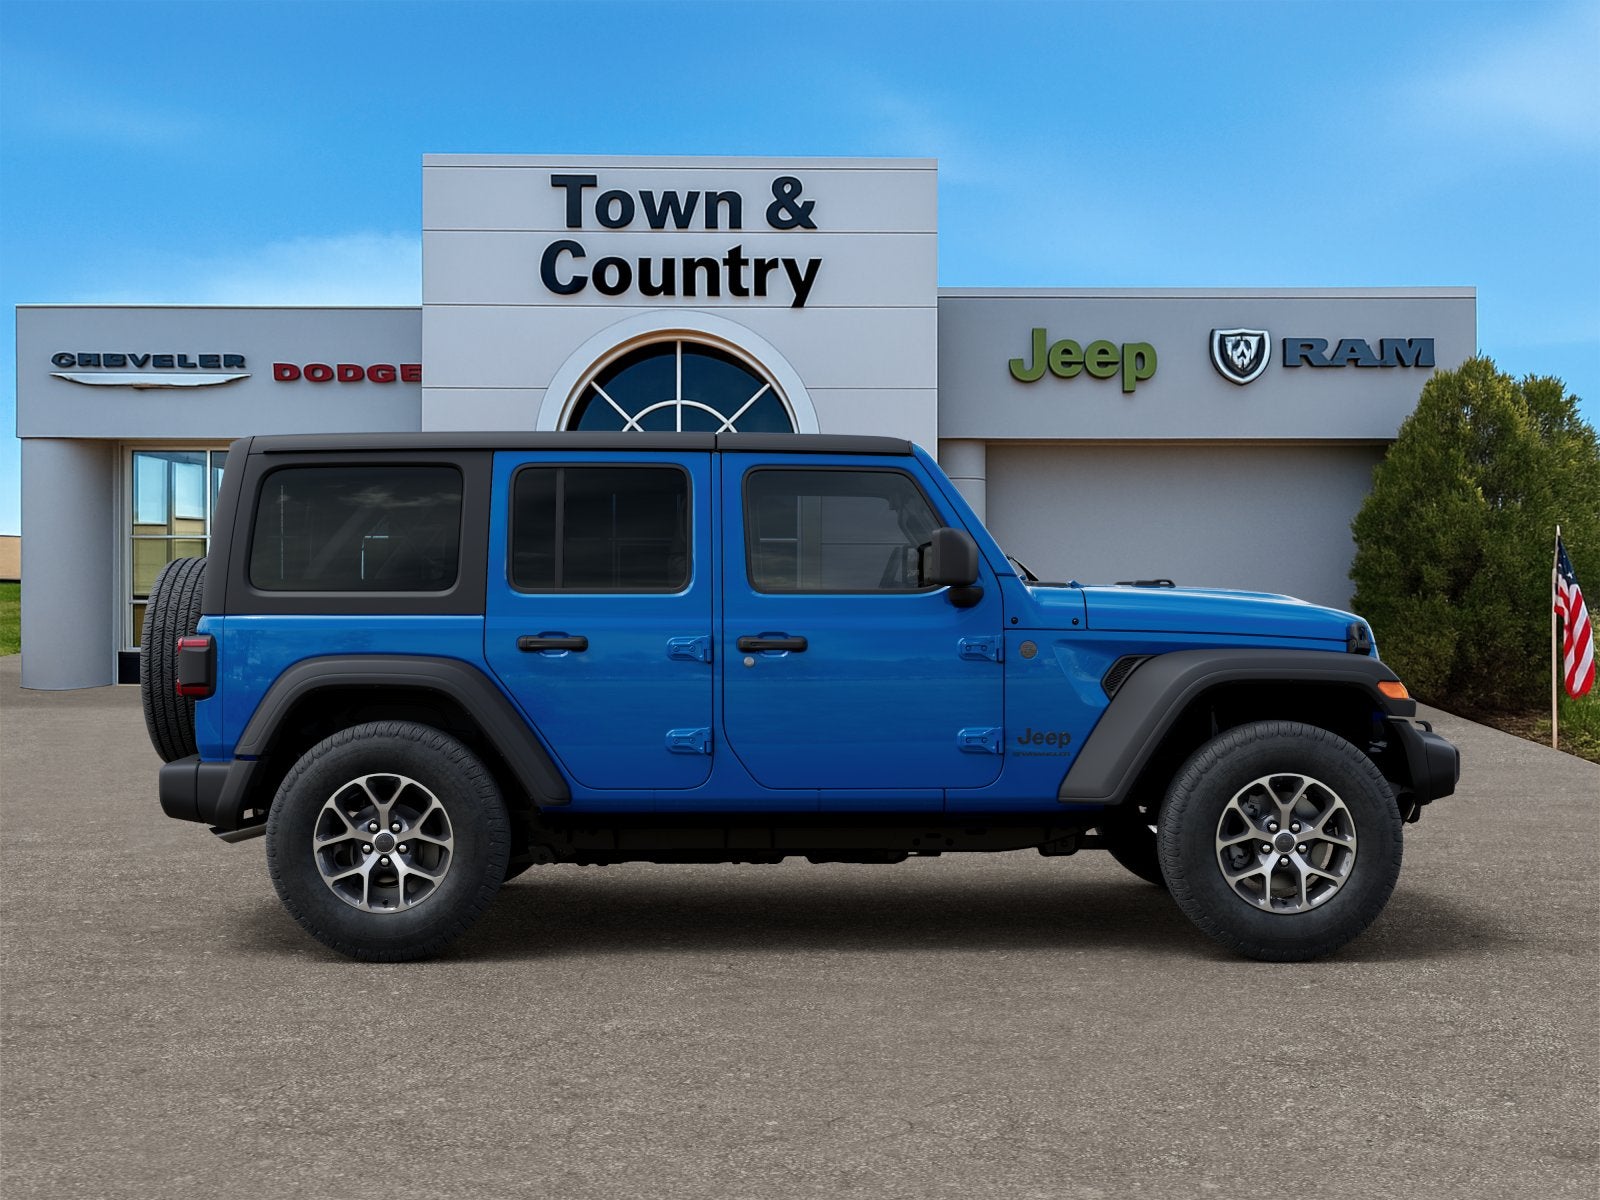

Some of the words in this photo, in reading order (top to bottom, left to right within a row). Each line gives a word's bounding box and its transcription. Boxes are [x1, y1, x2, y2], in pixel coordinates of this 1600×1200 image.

[551, 174, 742, 229] Town
[765, 176, 818, 229] &
[540, 239, 822, 308] Country
[273, 362, 422, 382] DODGE
[1009, 327, 1158, 392] Jeep
[1282, 337, 1435, 367] RAM
[1017, 727, 1071, 749] Jeep
